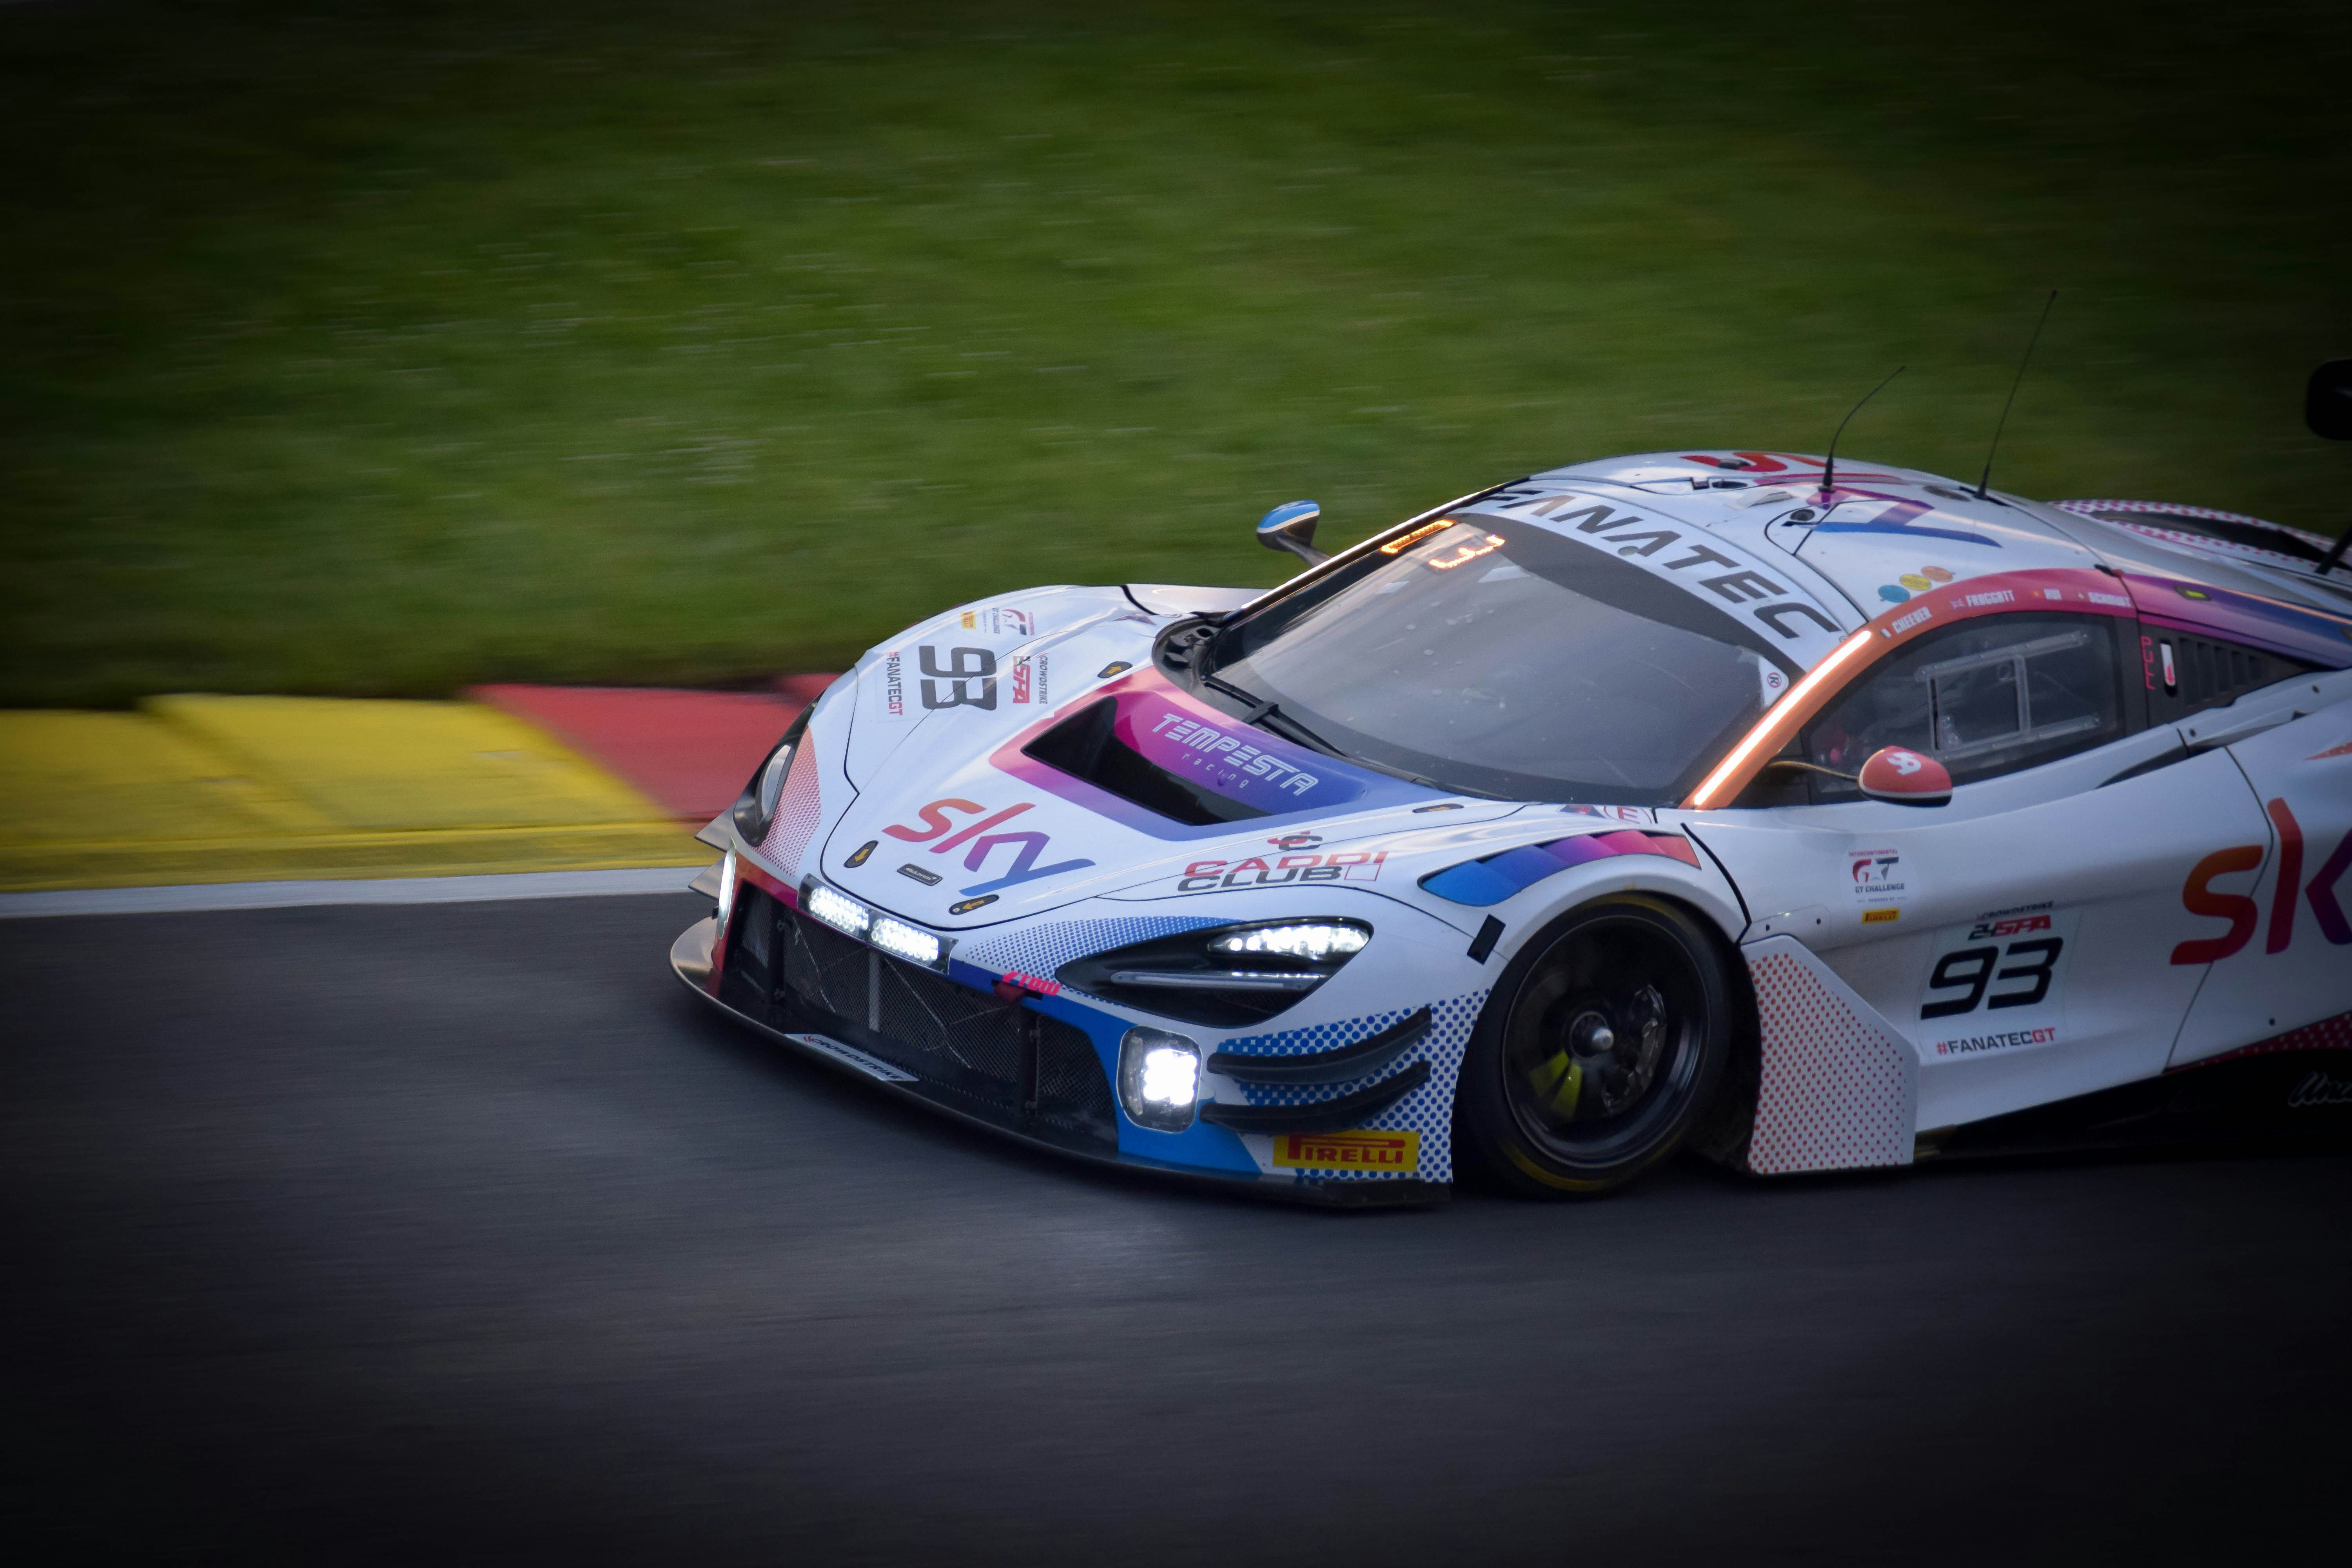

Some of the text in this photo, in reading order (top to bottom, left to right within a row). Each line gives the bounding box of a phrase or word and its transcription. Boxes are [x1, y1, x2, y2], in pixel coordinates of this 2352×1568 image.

[1892, 606, 1932, 634] CHEEVER
[918, 646, 997, 711] 93
[1039, 656, 1048, 704] CROWDSTRIKE
[2140, 635, 2156, 690] PULL
[886, 651, 903, 716] #FANATECGT
[1152, 713, 1319, 796] TEMPESTA
[1182, 753, 1249, 788] racing
[1177, 865, 1342, 892] CLUB
[1865, 883, 1905, 893] CHALLENGE
[1018, 973, 1062, 996] TOW
[1920, 936, 2063, 1020] 93
[1936, 1027, 2056, 1055] #FANATECGT
[1287, 1134, 1406, 1164] PIRELLI
